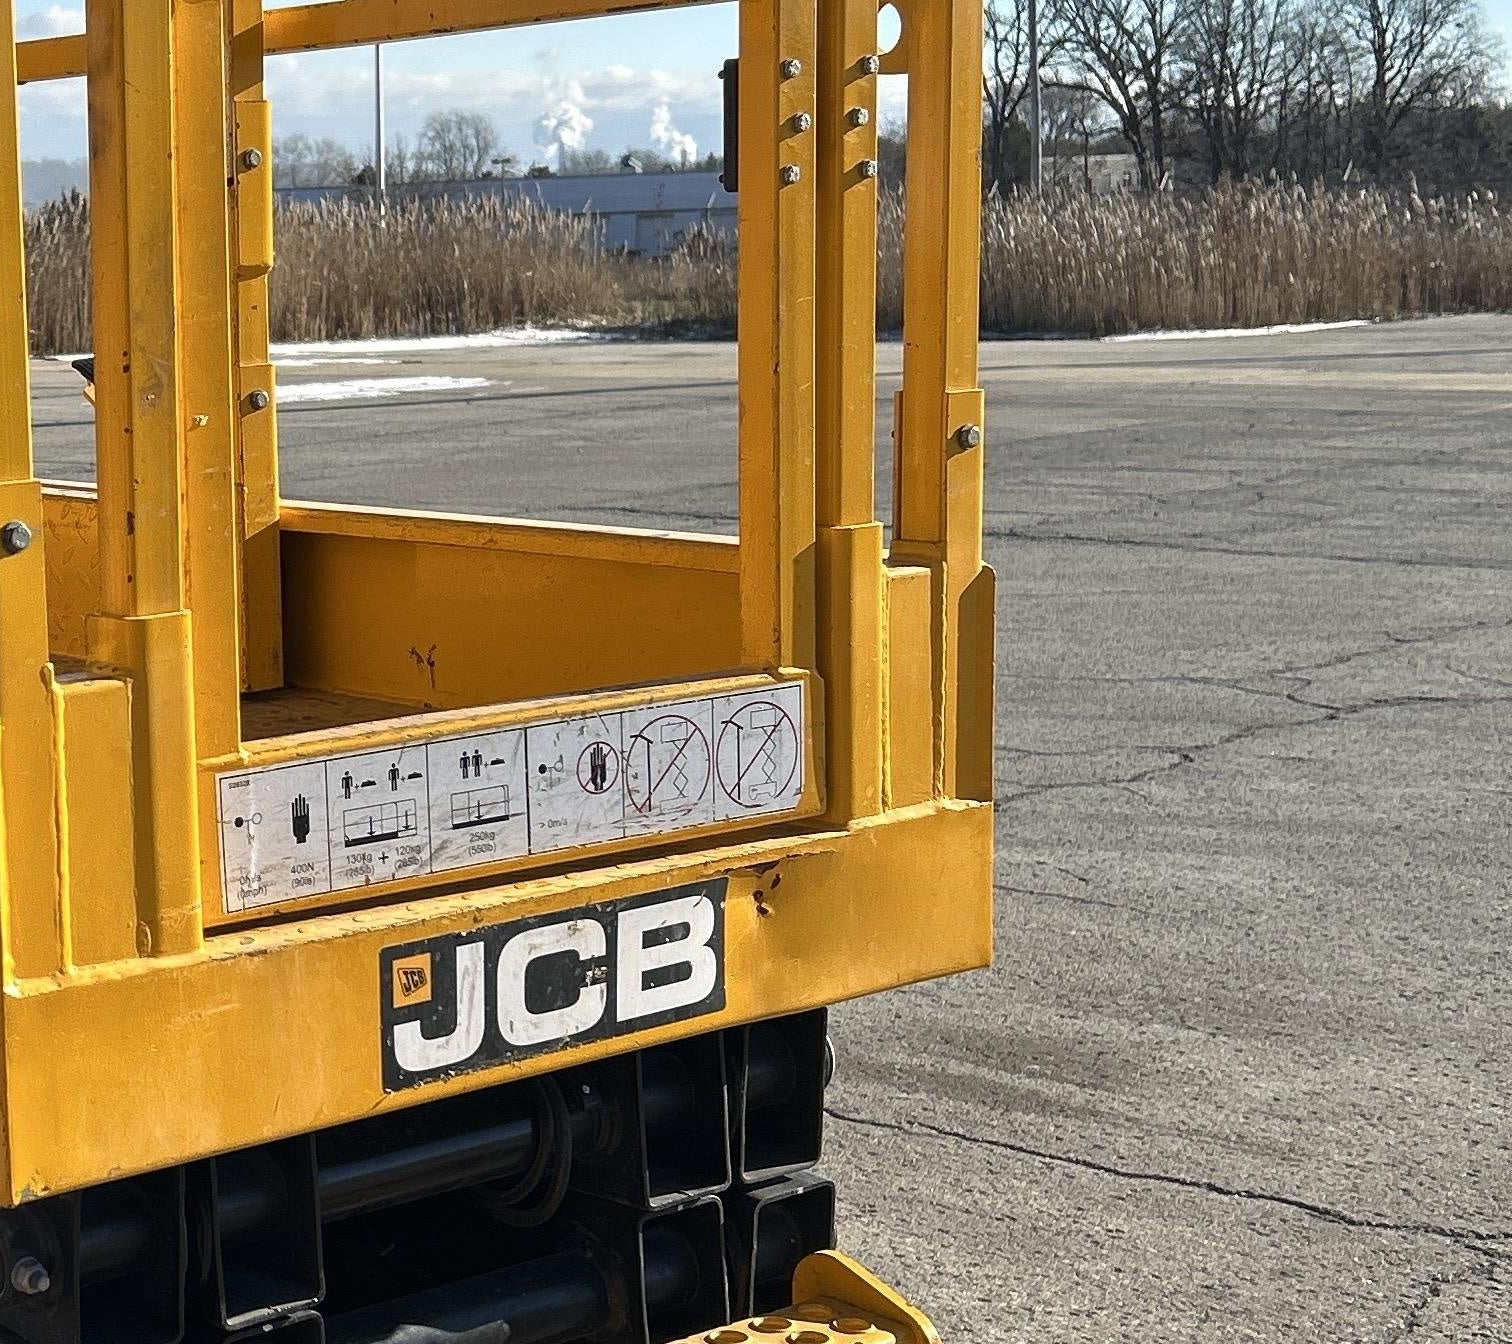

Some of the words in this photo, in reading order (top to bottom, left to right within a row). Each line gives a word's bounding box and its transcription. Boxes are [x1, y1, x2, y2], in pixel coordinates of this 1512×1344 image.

[290, 862, 315, 874] 400N
[393, 892, 717, 1072] JCB
[402, 969, 426, 994] JCB
